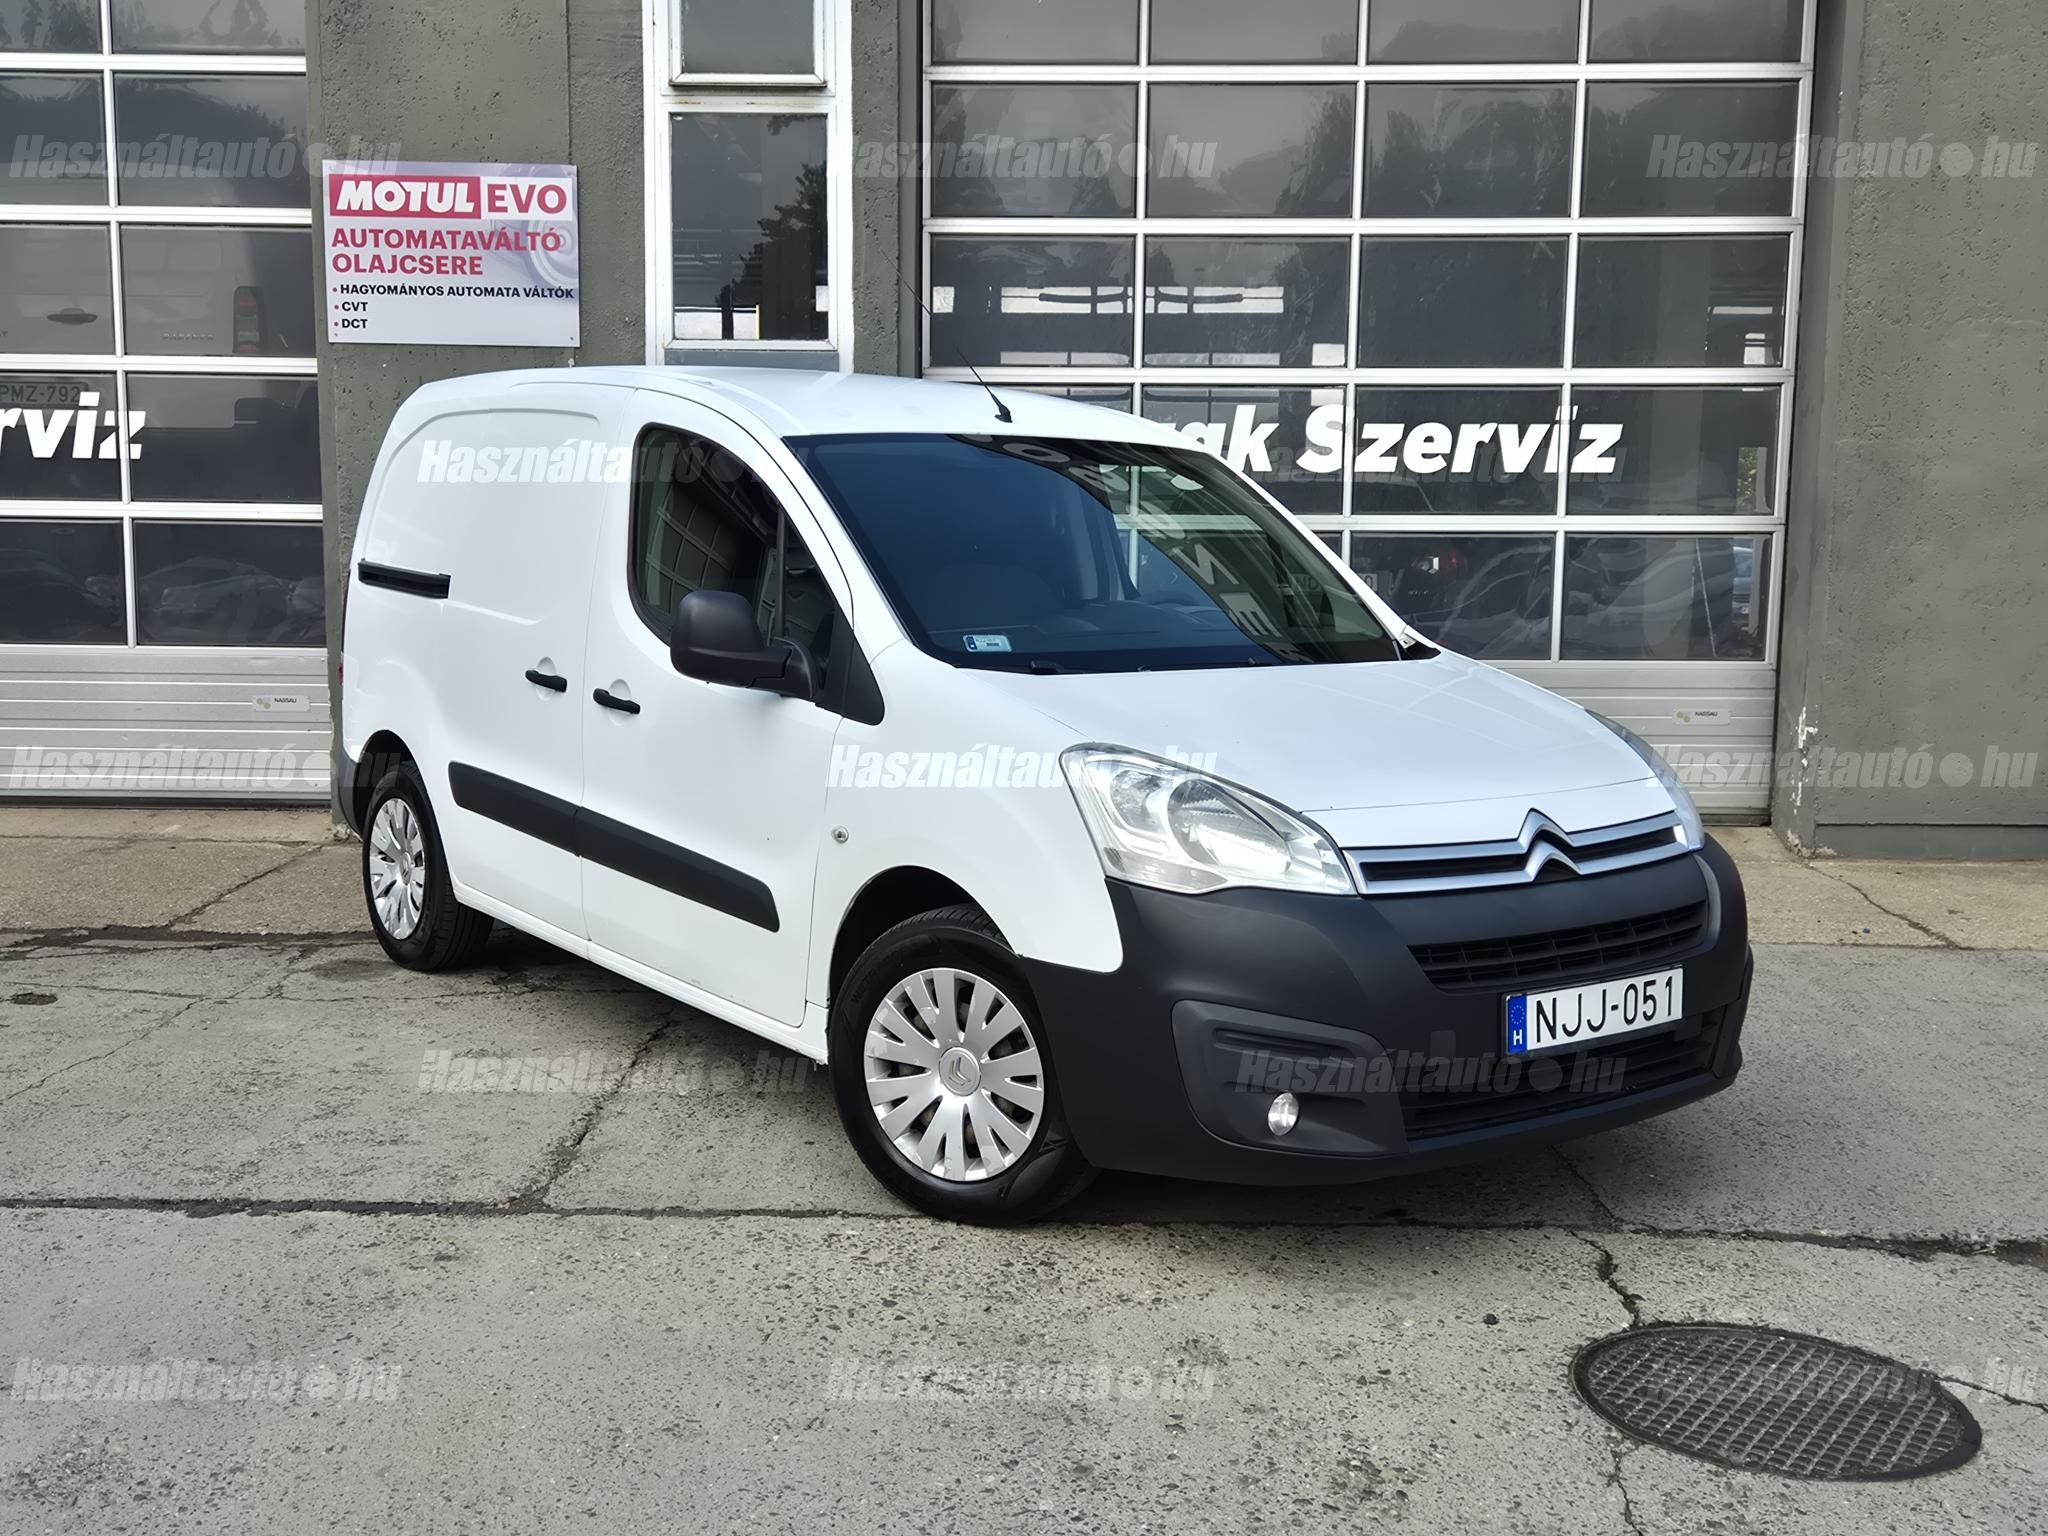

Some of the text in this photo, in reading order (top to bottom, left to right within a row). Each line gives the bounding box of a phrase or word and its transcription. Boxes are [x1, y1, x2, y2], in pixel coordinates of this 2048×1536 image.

[336, 180, 567, 215] MOTUL EVO
[331, 226, 562, 252] AUTOMATAVÁLTÓ
[332, 253, 484, 275] OLAJCSERE
[340, 283, 575, 299] HAGYOMÁNYOS AUTOMATA VÁLTÓK
[341, 302, 368, 312] CVT
[341, 319, 368, 329] DCT
[1296, 404, 1623, 474] Szerviz
[1536, 976, 1673, 1043] NJJ-051
[1513, 1029, 1523, 1046] H
